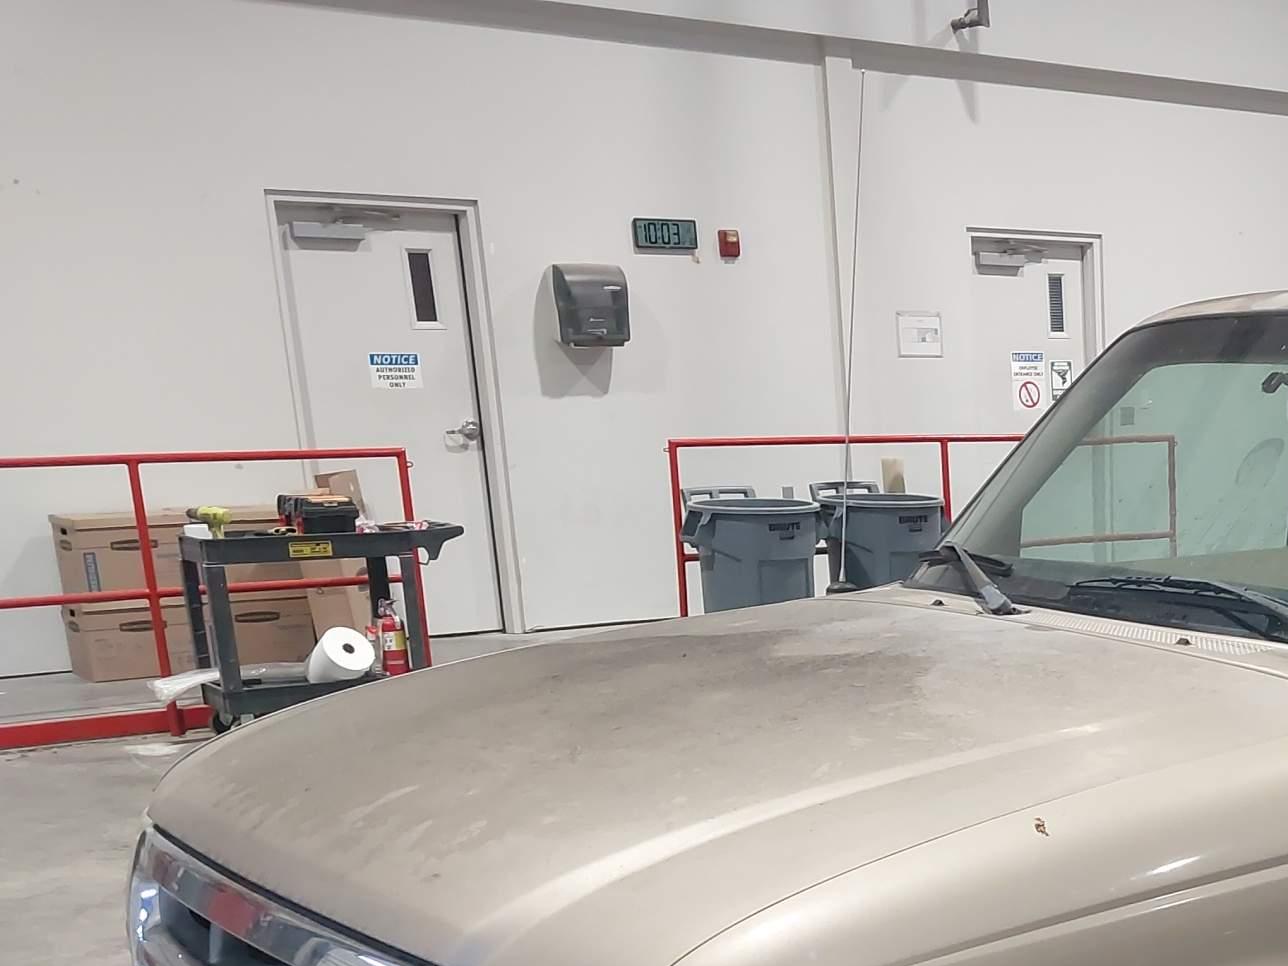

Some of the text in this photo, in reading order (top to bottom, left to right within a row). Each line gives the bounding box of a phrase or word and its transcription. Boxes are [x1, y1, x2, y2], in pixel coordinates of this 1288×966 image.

[643, 222, 681, 245] 10:03
[373, 354, 416, 365] NOTICE
[1012, 353, 1043, 362] NOTICE
